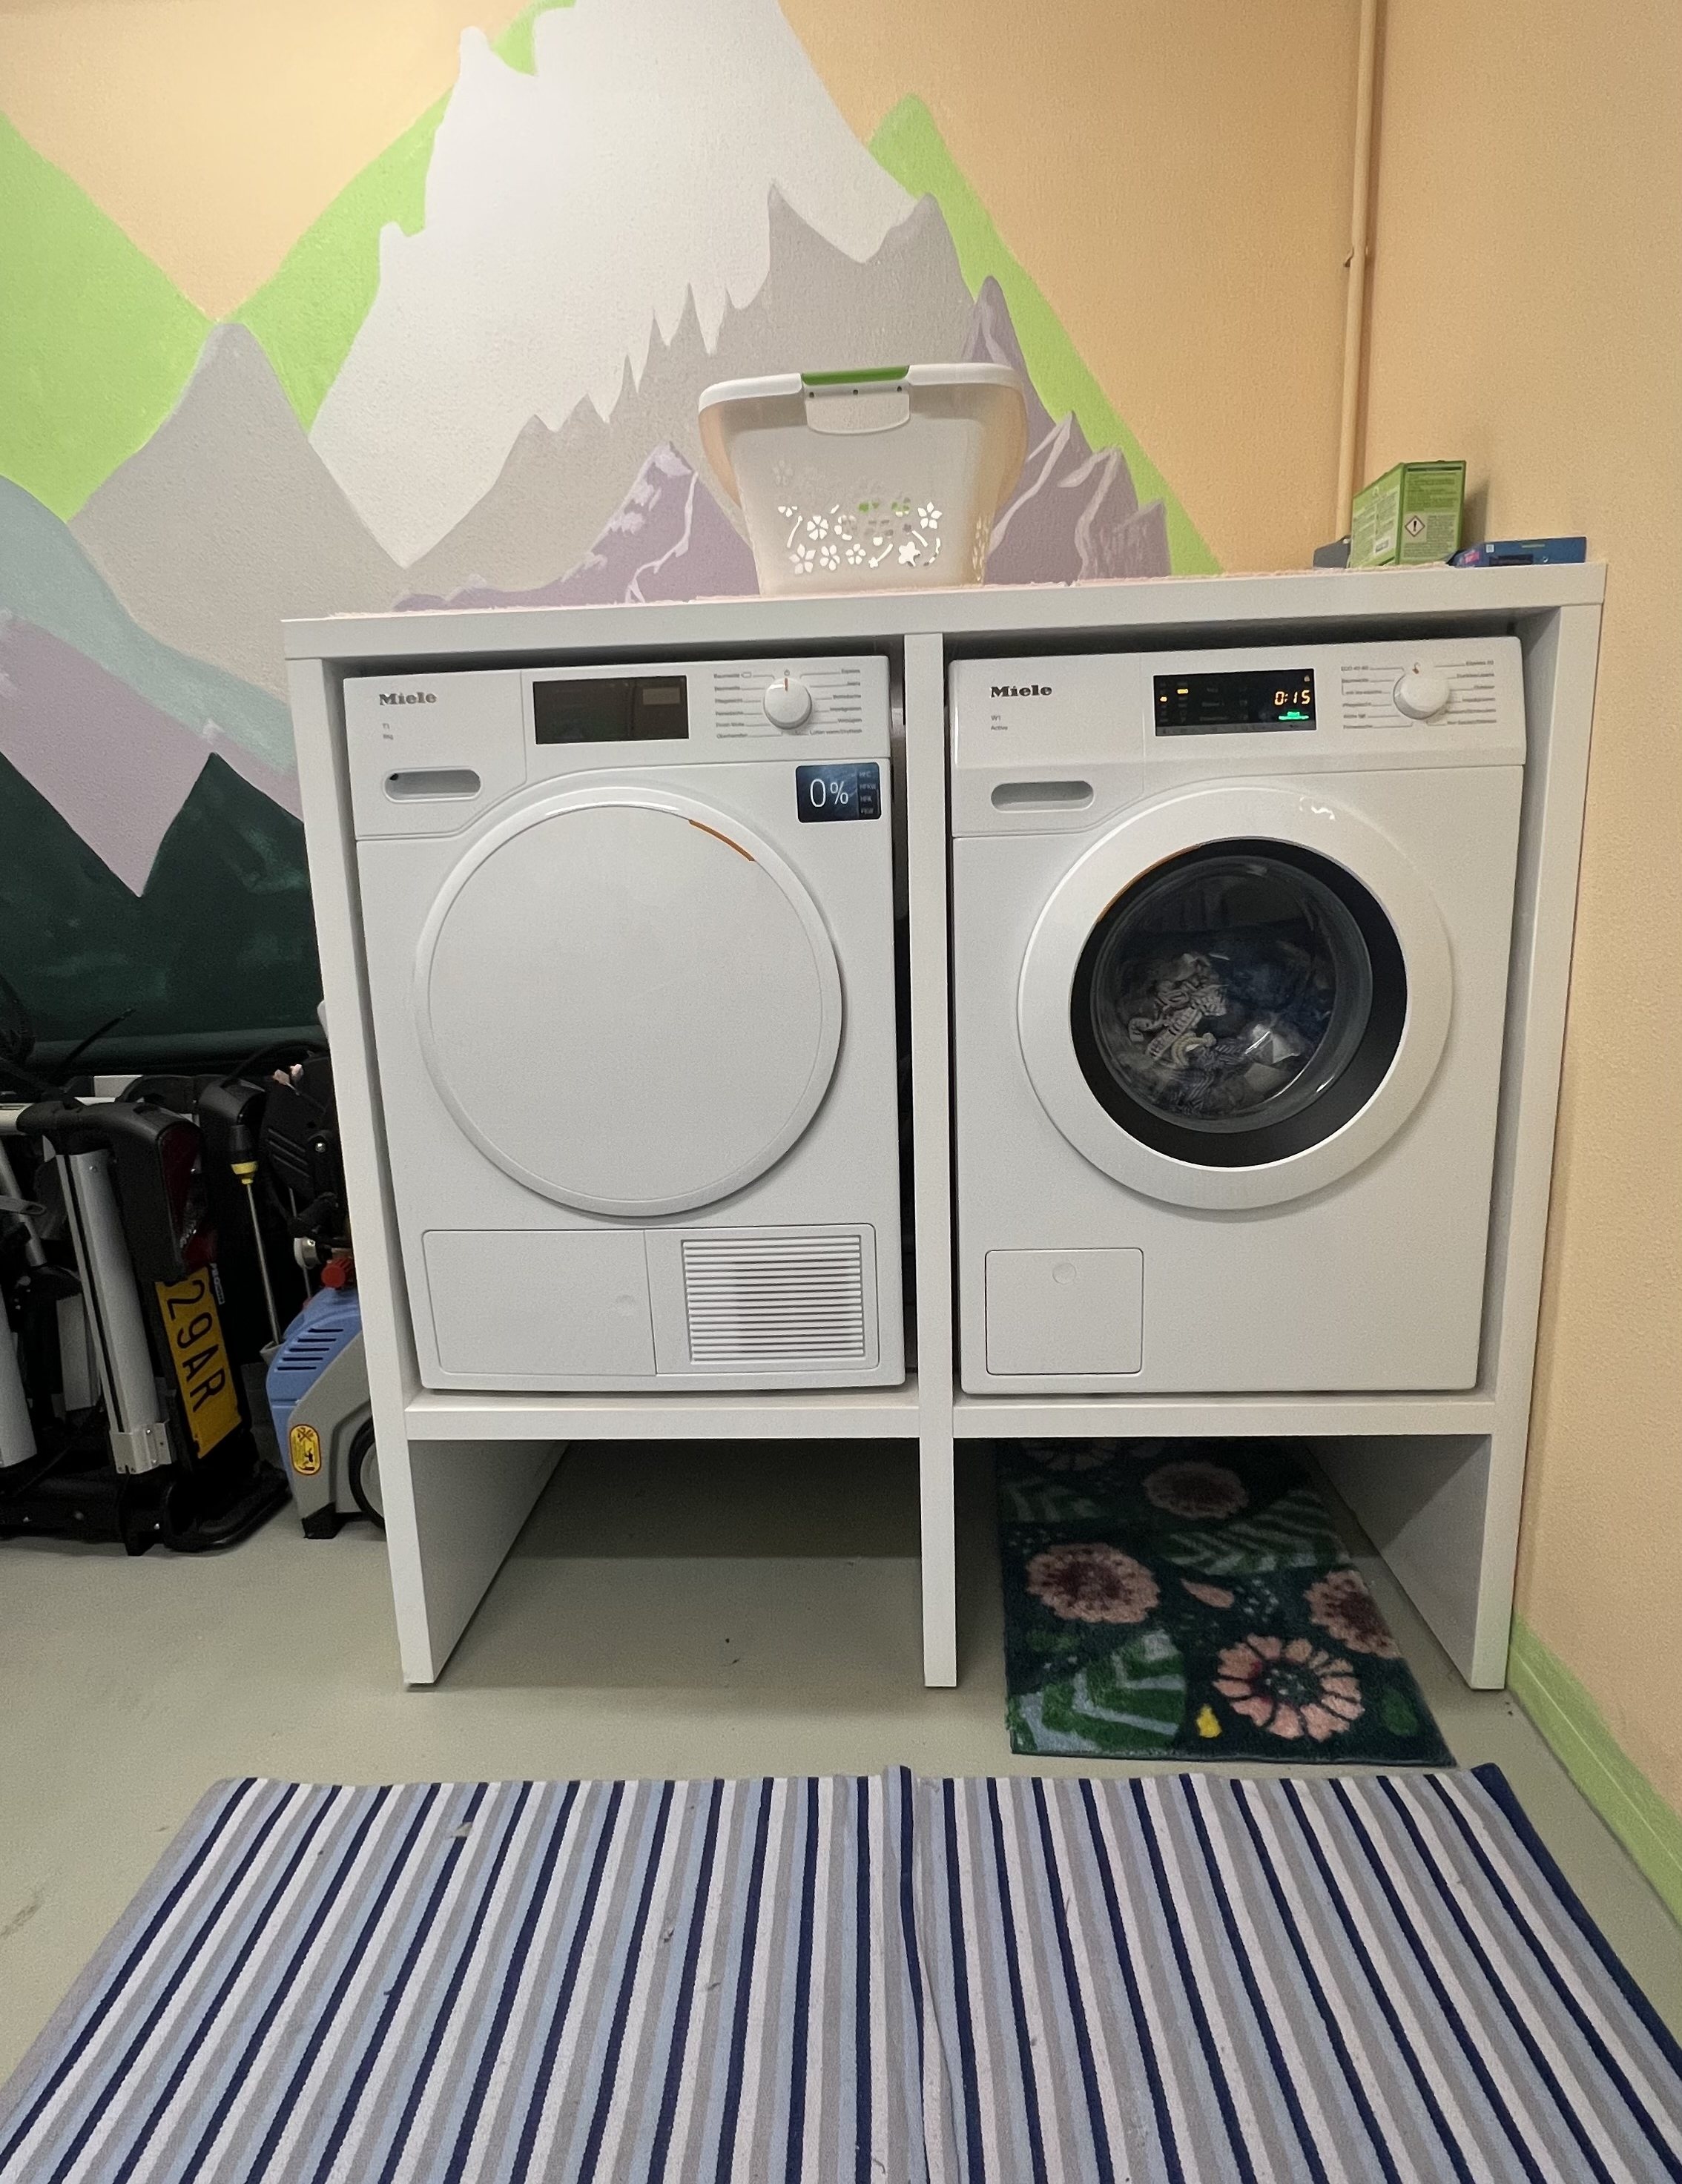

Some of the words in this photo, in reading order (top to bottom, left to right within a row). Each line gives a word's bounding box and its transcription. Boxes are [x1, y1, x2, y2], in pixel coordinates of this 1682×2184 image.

[991, 684, 1052, 698] Miele
[1274, 690, 1310, 705] 0:15
[379, 692, 437, 706] Miele
[810, 779, 849, 808] 0%
[167, 1279, 226, 1413] 29AR
